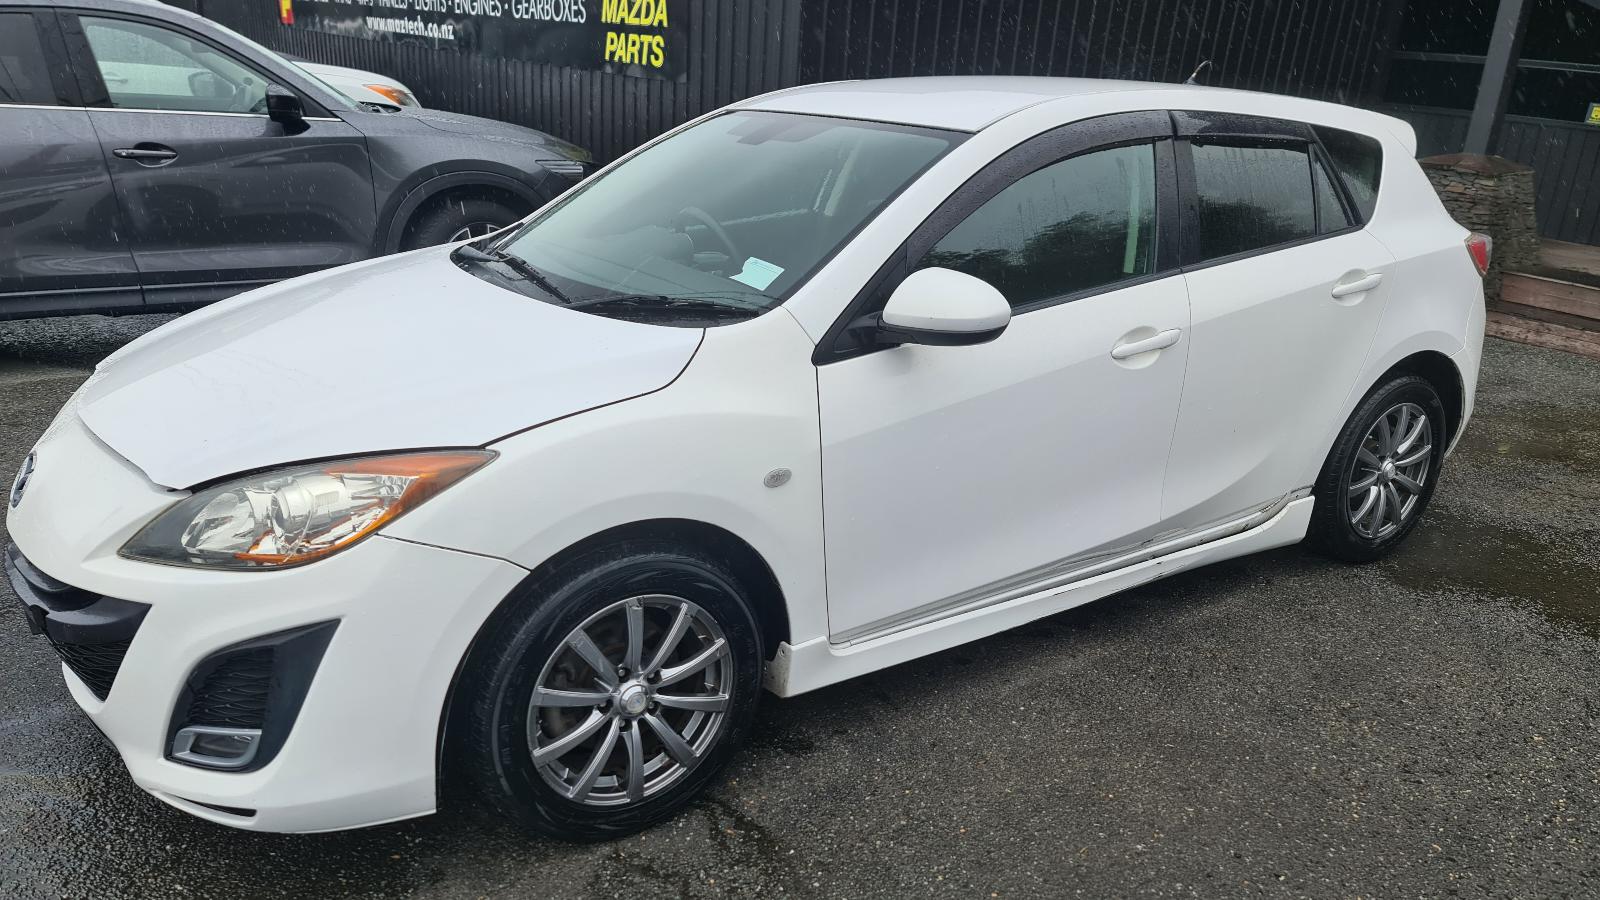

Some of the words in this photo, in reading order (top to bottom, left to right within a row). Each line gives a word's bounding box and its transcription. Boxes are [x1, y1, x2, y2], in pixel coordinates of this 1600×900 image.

[455, 0, 502, 17] ENGINES
[512, 0, 587, 23] GEARBOXES
[601, 0, 668, 27] MAZDA
[366, 15, 454, 39] www.maztech.co.nz
[605, 32, 665, 68] PARTS
